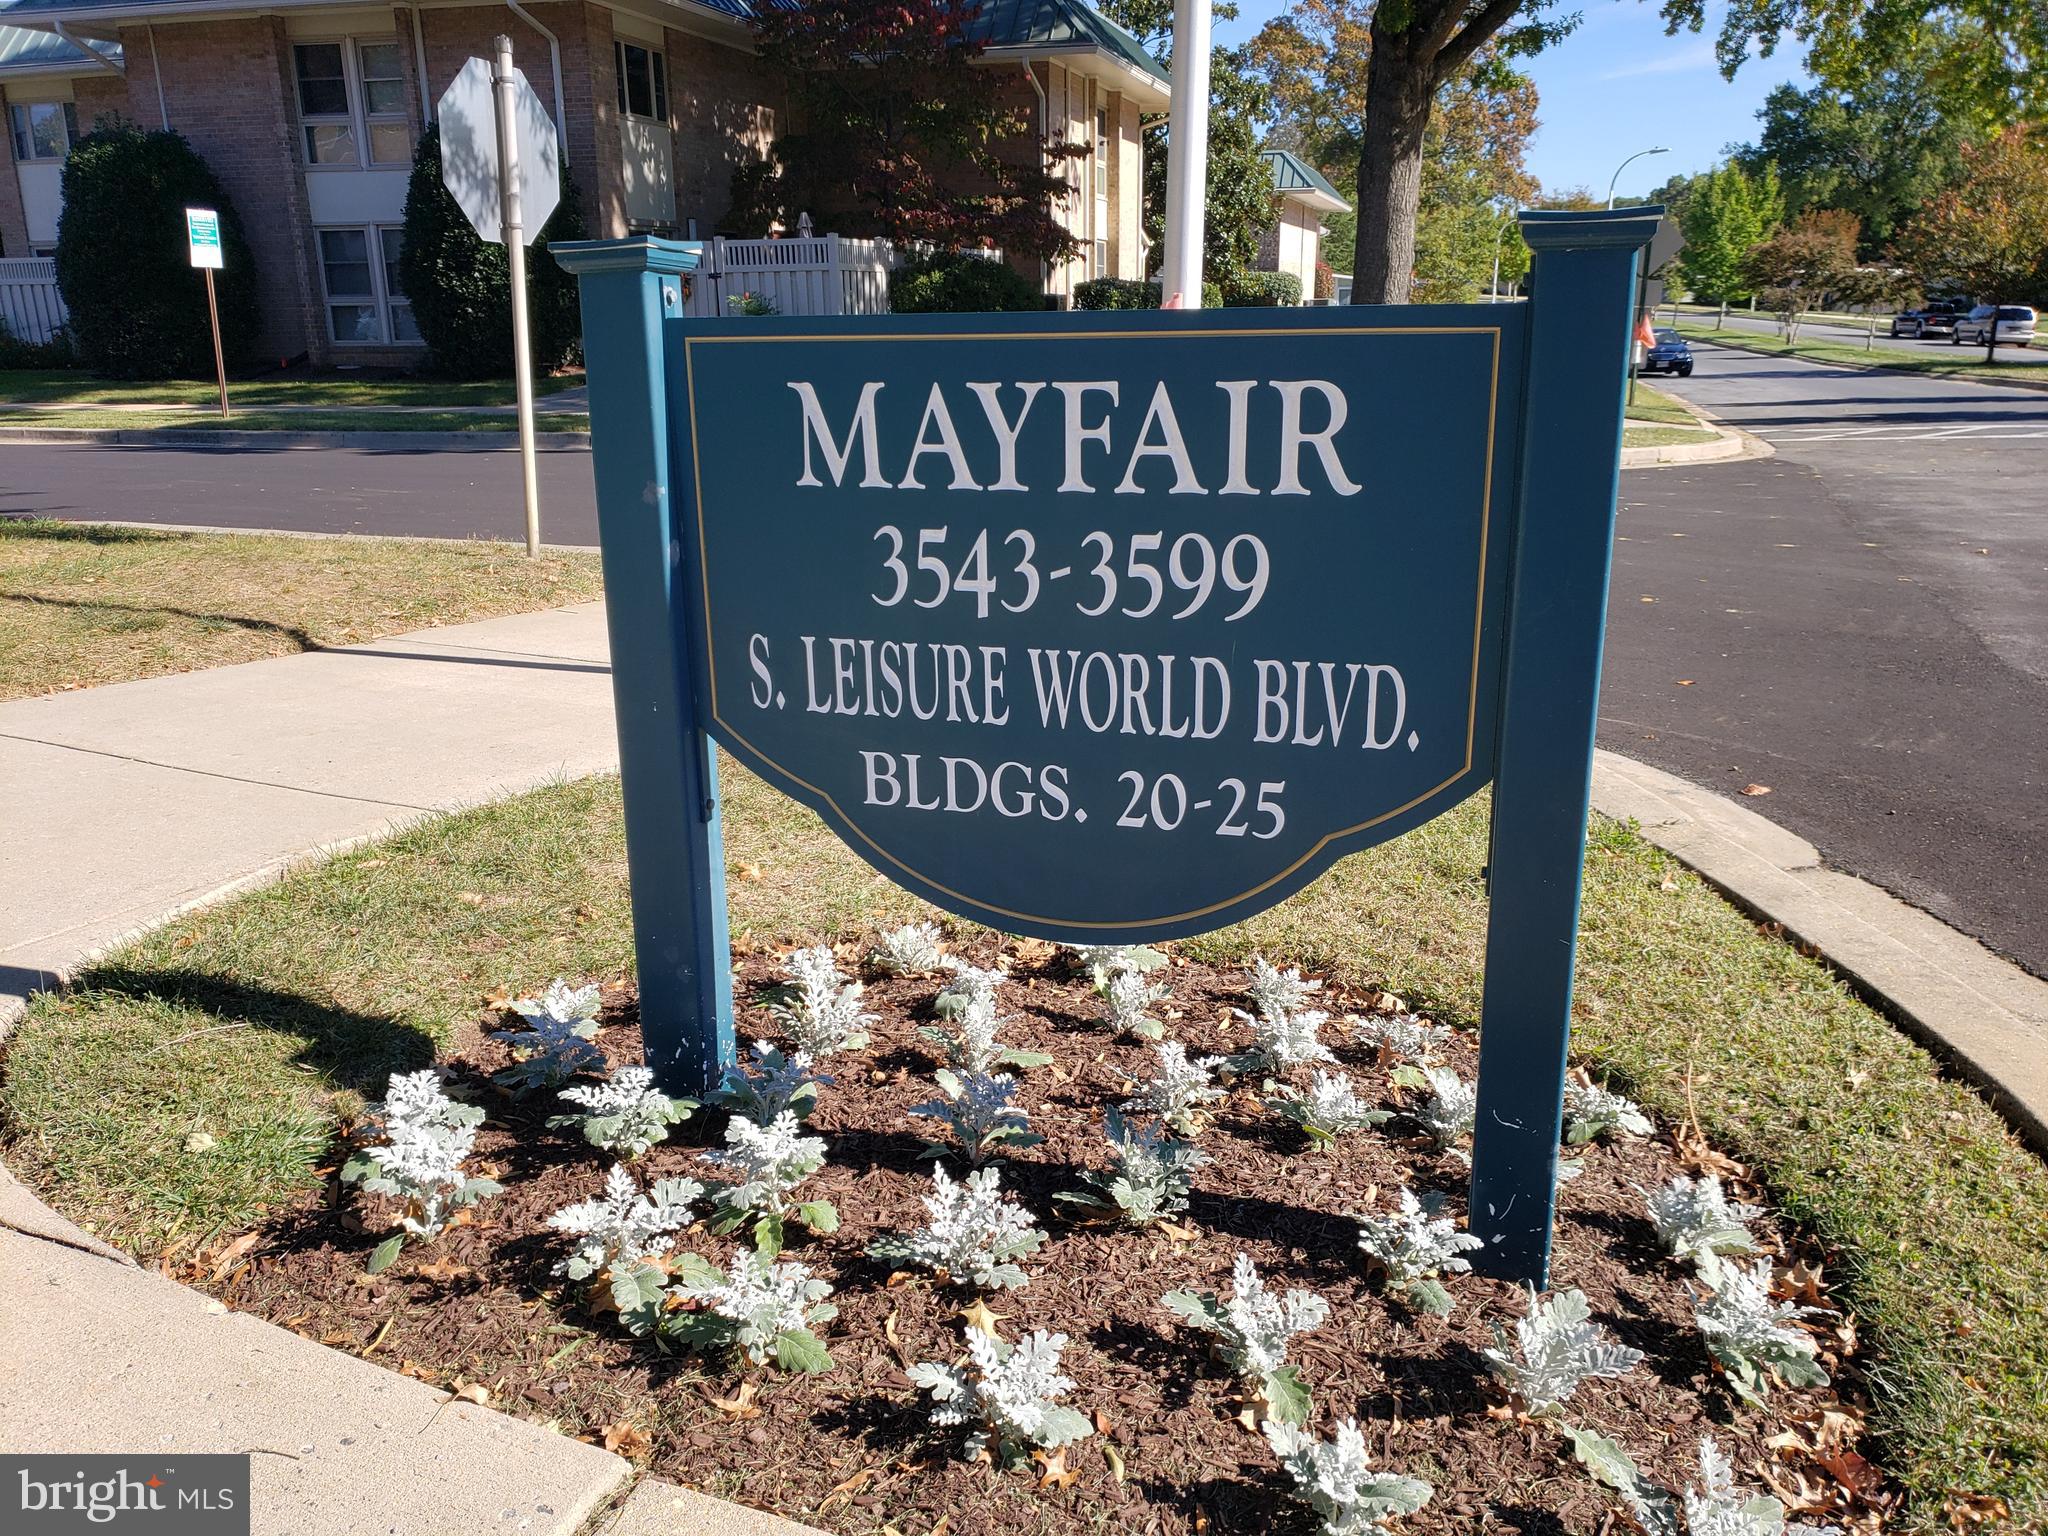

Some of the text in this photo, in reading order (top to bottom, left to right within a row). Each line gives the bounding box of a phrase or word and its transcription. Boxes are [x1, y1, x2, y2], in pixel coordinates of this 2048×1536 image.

[787, 379, 1364, 497] MAYFAIR
[871, 525, 1271, 622] 3543-3599
[749, 633, 1421, 753] S. LEISURE WORLD BLVD.
[858, 750, 1287, 842] BLDGS. 20-25
